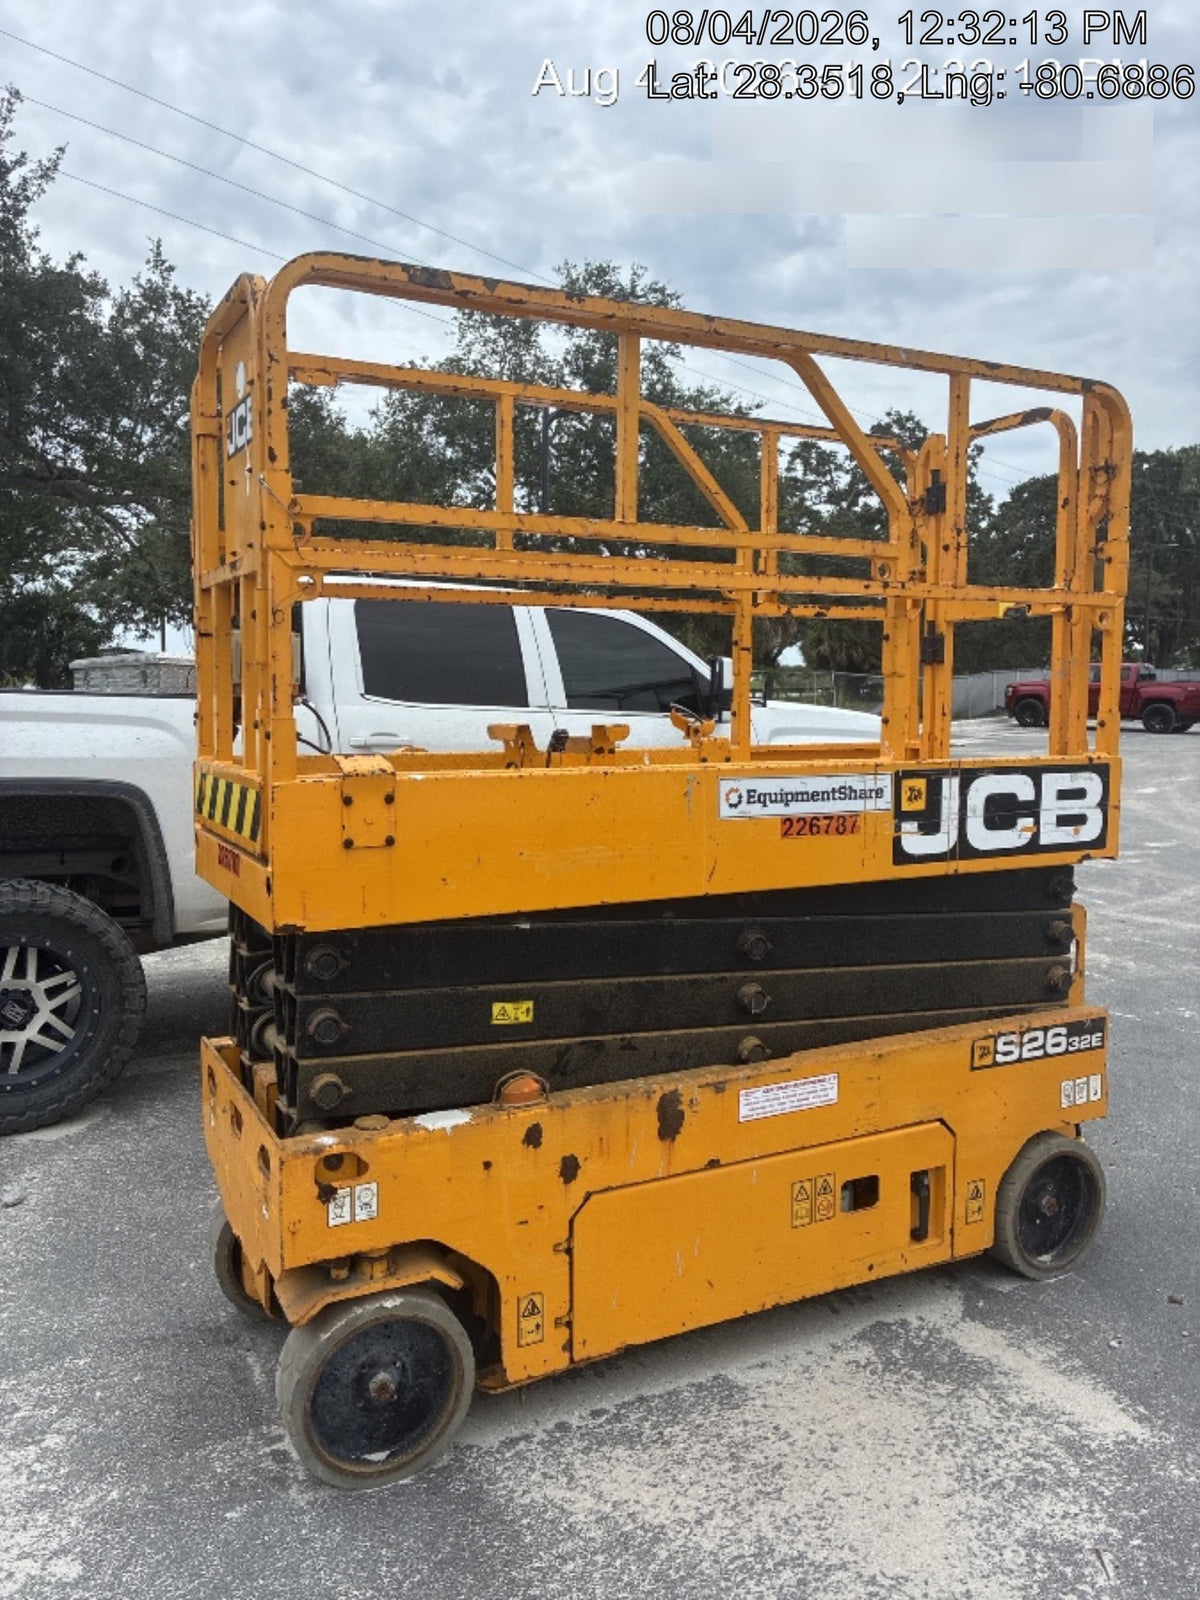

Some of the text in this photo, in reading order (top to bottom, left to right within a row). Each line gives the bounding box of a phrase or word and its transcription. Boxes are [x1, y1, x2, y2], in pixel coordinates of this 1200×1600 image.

[746, 786, 885, 808] EquipmentShare
[782, 815, 858, 837] 226787
[901, 771, 1104, 855] JCB
[995, 1026, 1103, 1063] S26 32E
